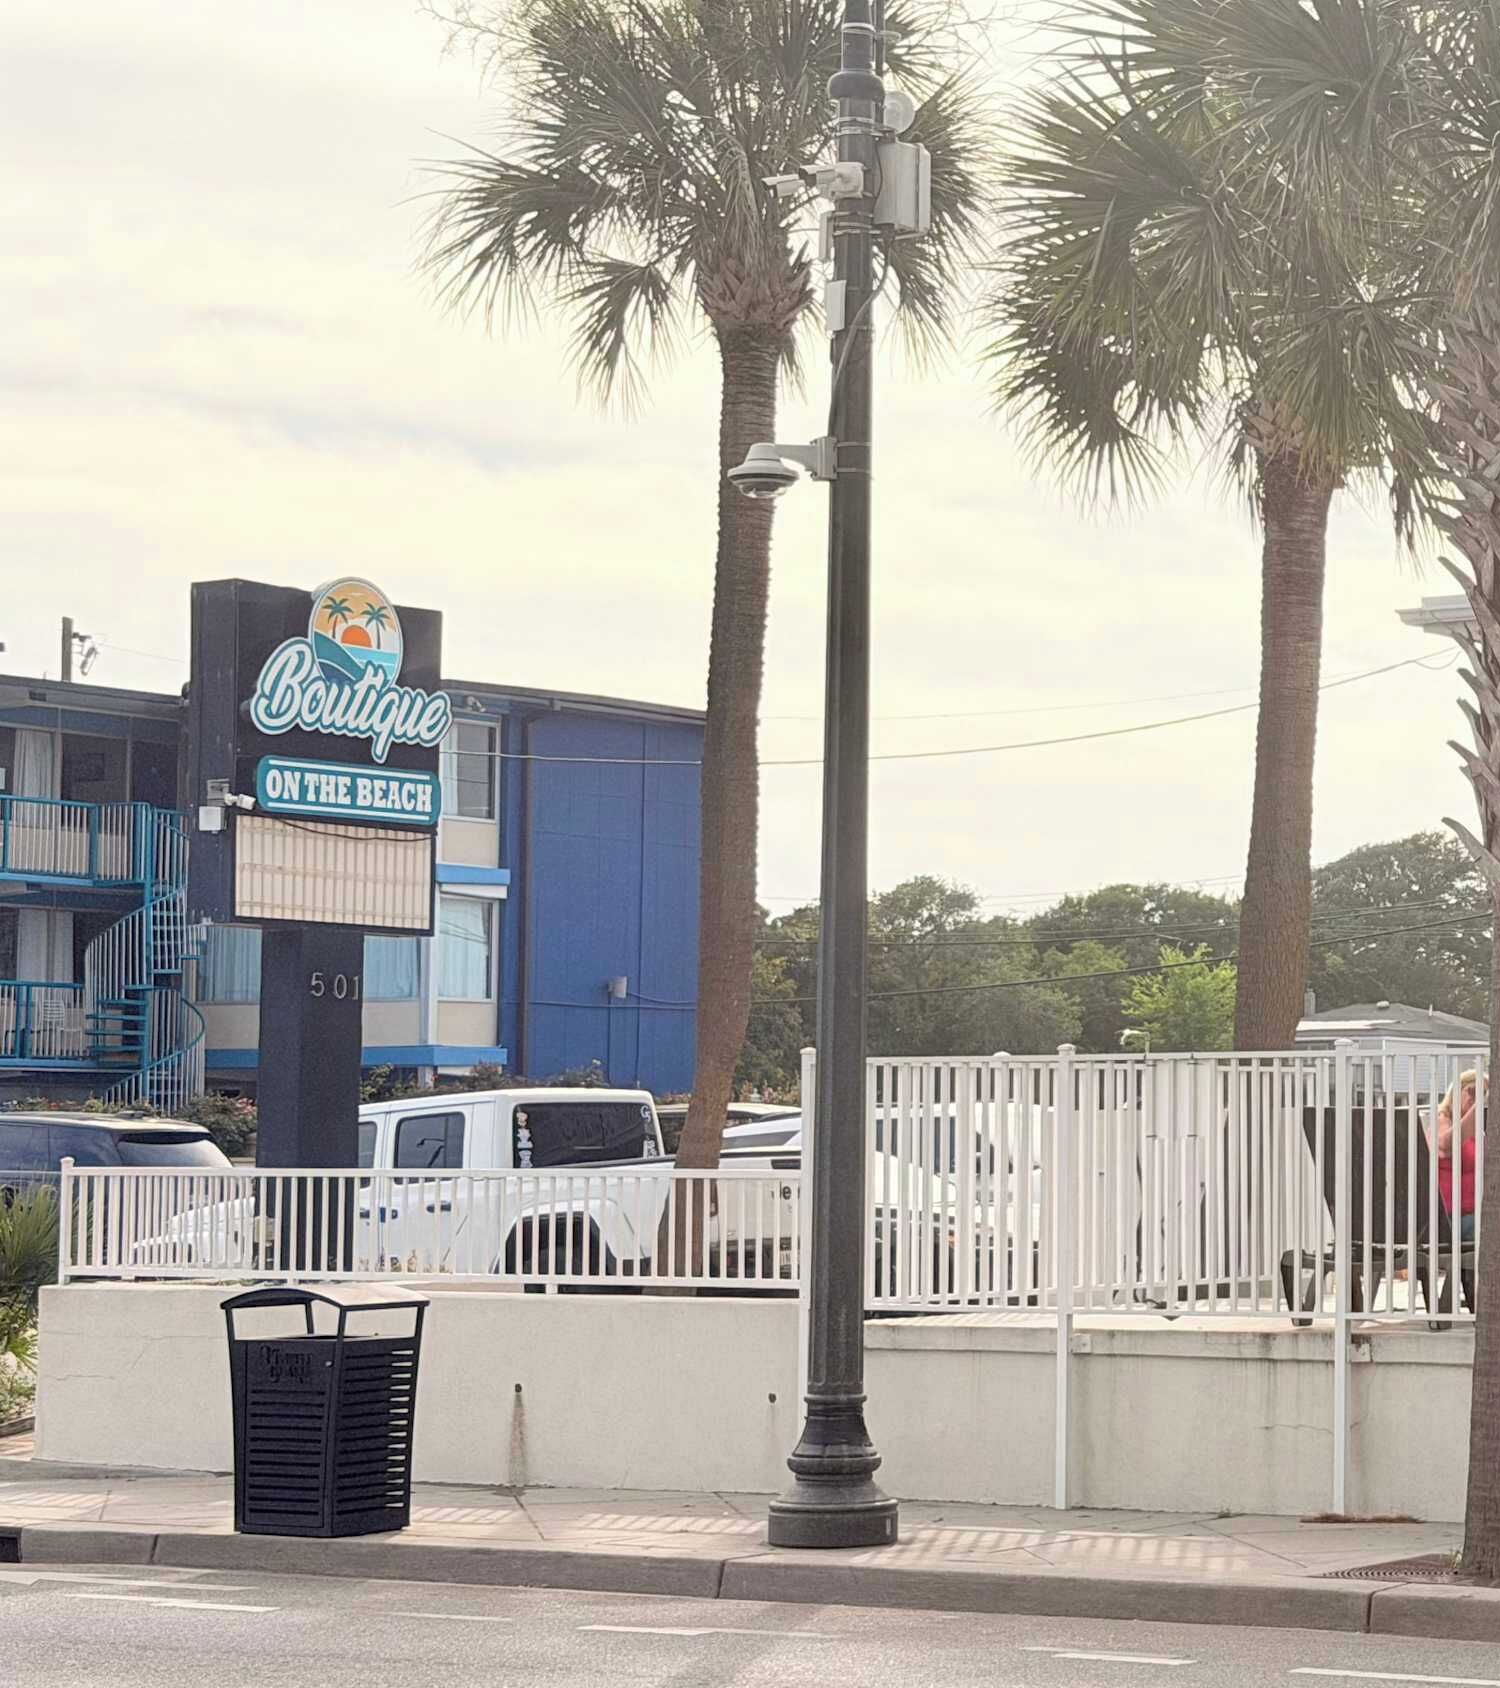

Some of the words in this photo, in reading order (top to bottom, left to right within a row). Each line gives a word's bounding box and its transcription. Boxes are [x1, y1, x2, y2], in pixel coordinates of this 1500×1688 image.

[255, 642, 448, 757] Boutique
[265, 768, 302, 801] ON
[304, 772, 351, 805] THE
[356, 777, 433, 812] BEACH
[310, 972, 360, 1000] 501
